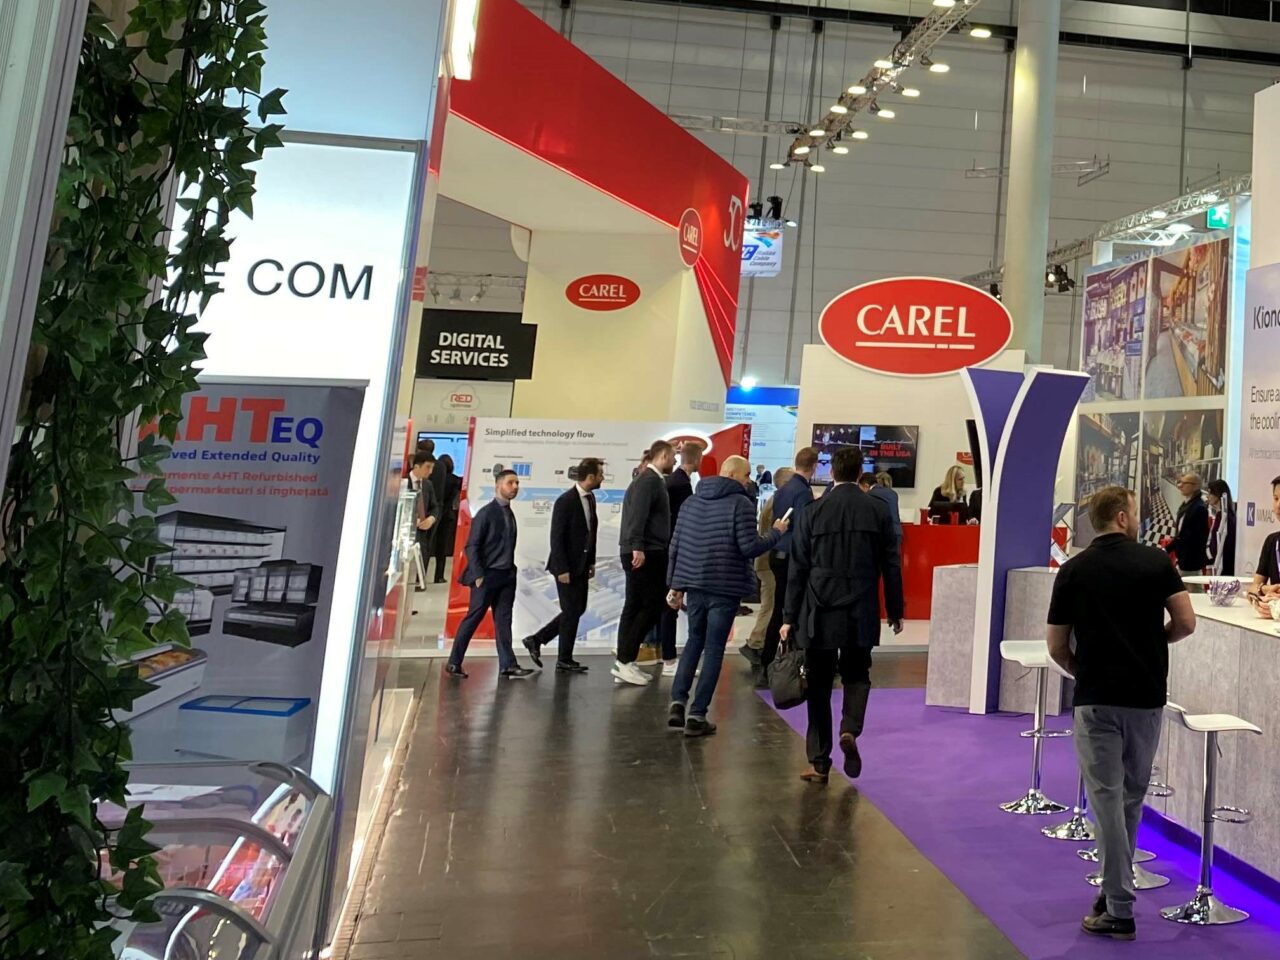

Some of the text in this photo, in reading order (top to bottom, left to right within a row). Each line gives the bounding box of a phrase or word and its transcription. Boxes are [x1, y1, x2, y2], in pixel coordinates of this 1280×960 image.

[683, 222, 699, 247] CAREL
[247, 258, 374, 301] COM
[578, 283, 627, 299] CAREL
[856, 303, 976, 337] CAREL
[438, 332, 505, 350] DIGITAL
[429, 349, 510, 368] SERVICES
[1251, 385, 1274, 403] Ensure
[1250, 412, 1260, 430] the
[485, 428, 595, 440] Simplified technology flow
[201, 450, 267, 462] Extended
[271, 451, 321, 465] Quality
[212, 471, 240, 481] AHT
[243, 471, 319, 483] Refurbished
